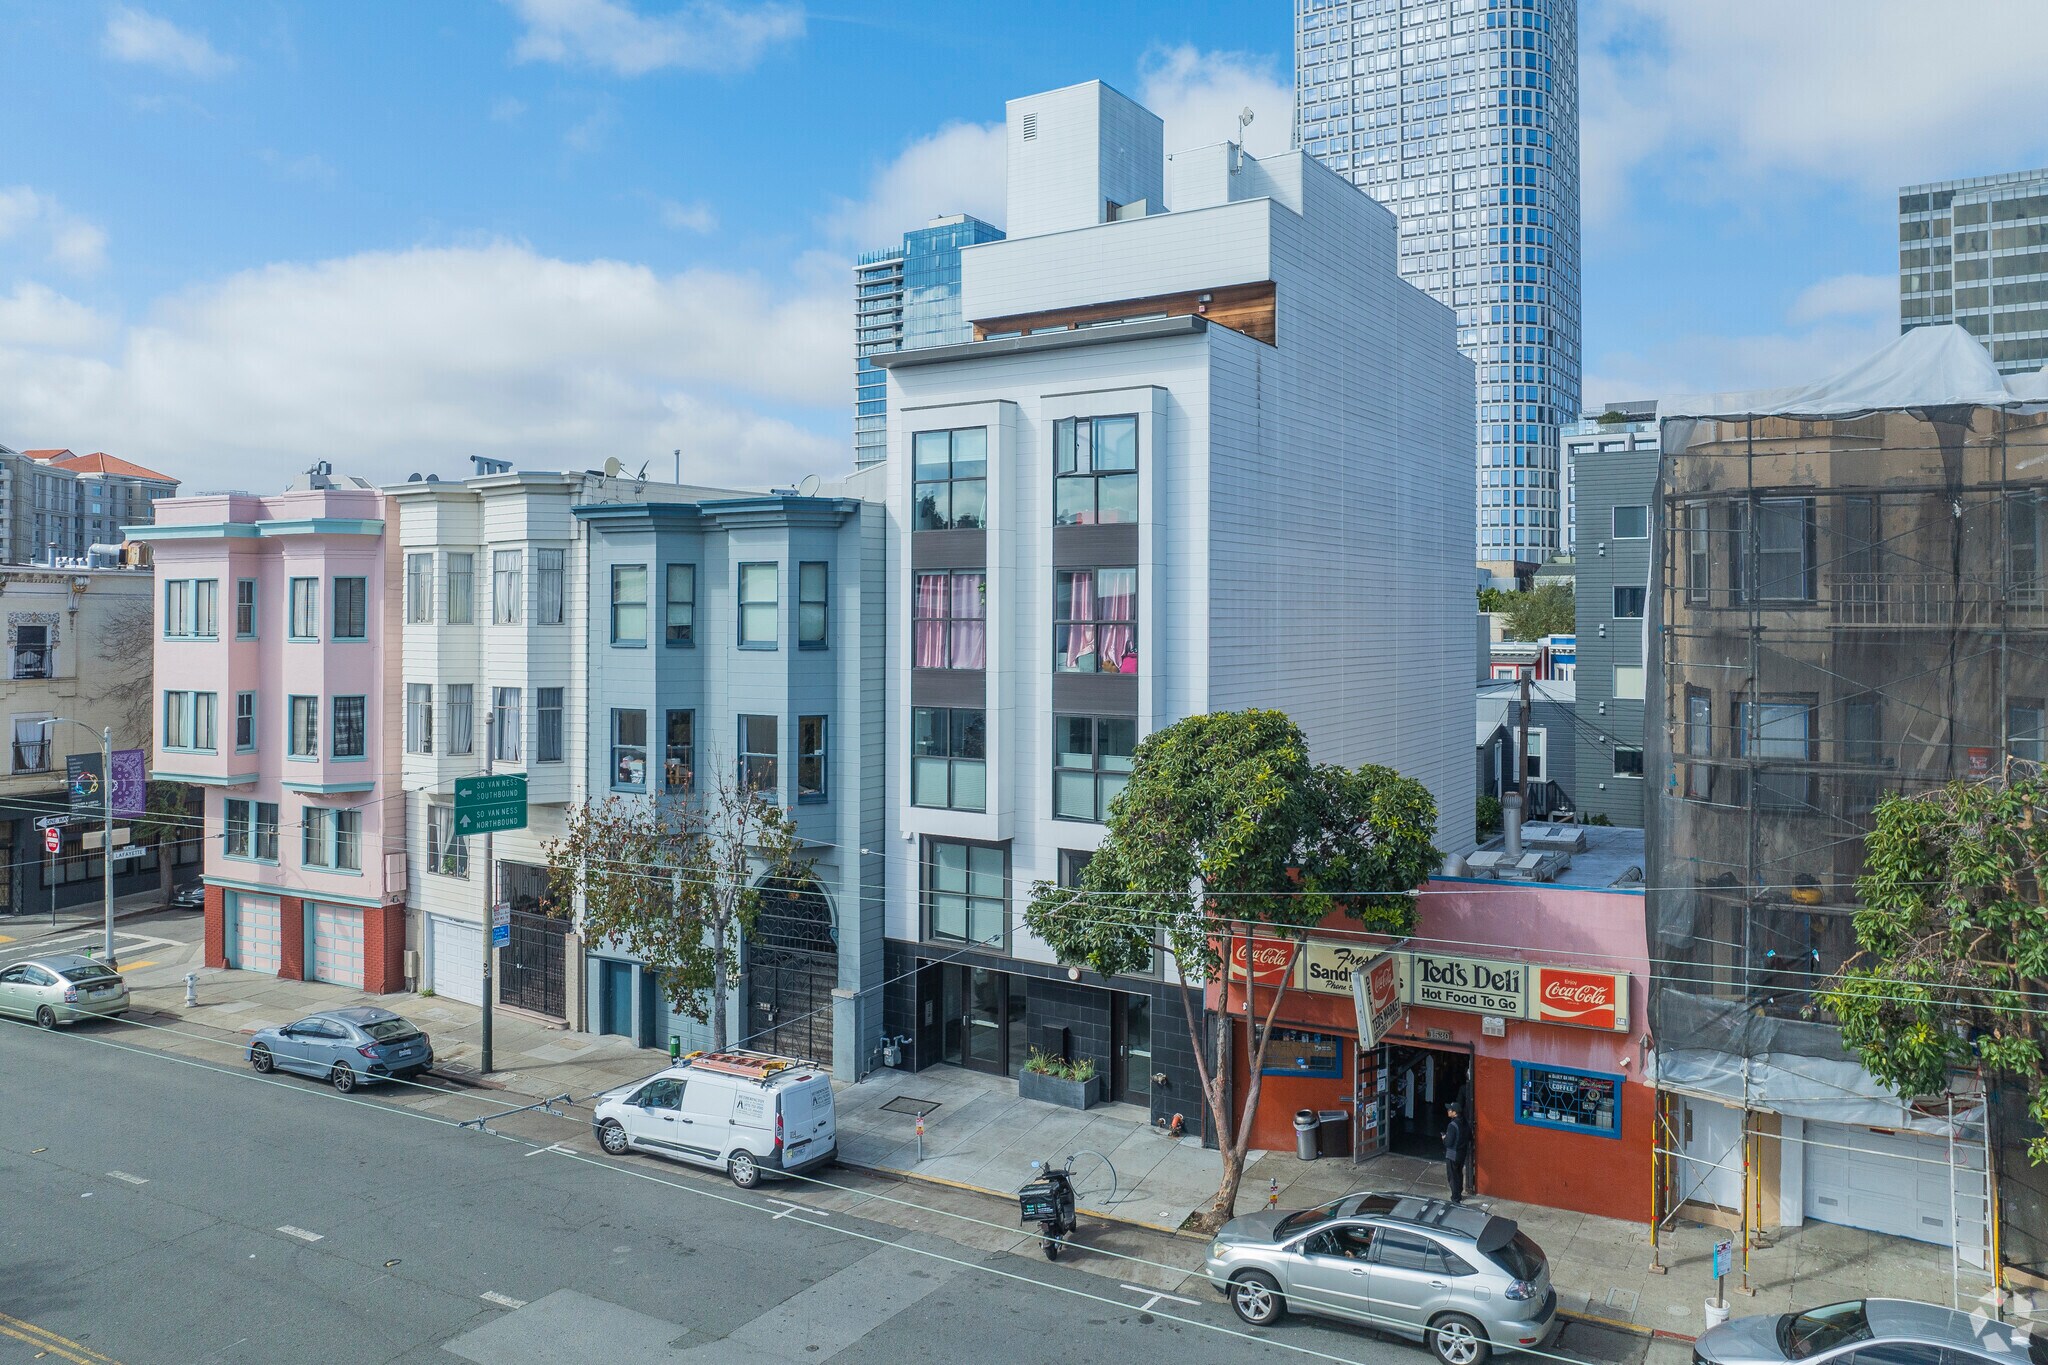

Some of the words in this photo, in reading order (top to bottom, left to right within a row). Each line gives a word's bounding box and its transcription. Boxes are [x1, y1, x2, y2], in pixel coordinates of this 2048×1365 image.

[476, 781, 485, 789] SO
[488, 780, 500, 788] VAN
[501, 779, 518, 787] NESS
[476, 789, 518, 800] SOUTHBOUND
[476, 810, 485, 819] SO
[488, 809, 500, 817] VAN
[501, 807, 518, 815] NESS
[476, 818, 518, 829] NORTHBOUND
[115, 850, 143, 859] LAFAYETTE
[1236, 945, 1288, 965] Coa-Cola
[1334, 948, 1380, 970] Fres
[1417, 957, 1468, 987] Ted's
[1472, 963, 1520, 993] Deli
[1325, 980, 1347, 991] Phone
[1545, 981, 1609, 1005] Coca-Cola
[1421, 988, 1442, 1000] Hot
[1446, 991, 1477, 1004] Food
[1480, 995, 1494, 1007] To
[1498, 998, 1517, 1010] Go
[1552, 1083, 1574, 1092] COFFEE
